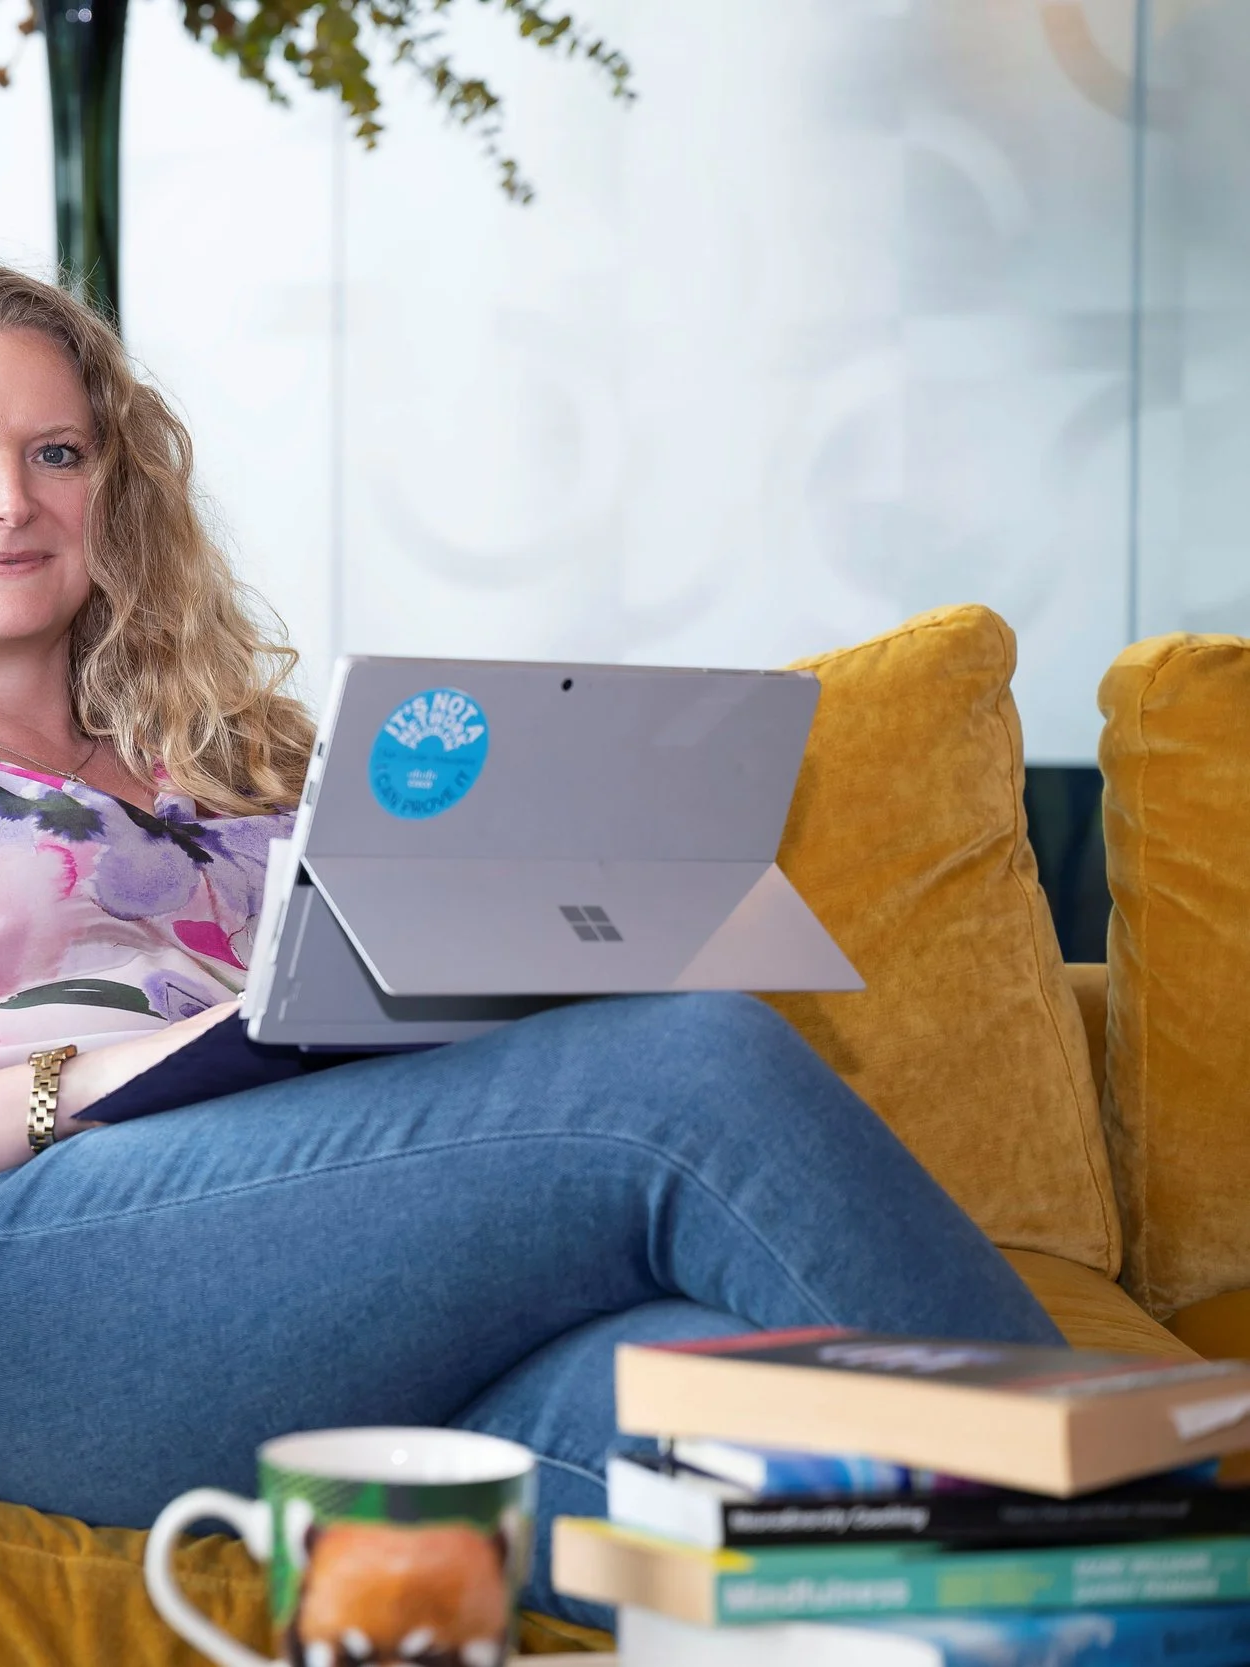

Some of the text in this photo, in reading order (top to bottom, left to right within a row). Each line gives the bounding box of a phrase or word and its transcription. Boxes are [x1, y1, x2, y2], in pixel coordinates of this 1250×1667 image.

[384, 695, 428, 736] IT'S
[432, 691, 478, 723] NOT
[464, 723, 485, 744] A
[724, 1575, 911, 1612] Mindfulness
